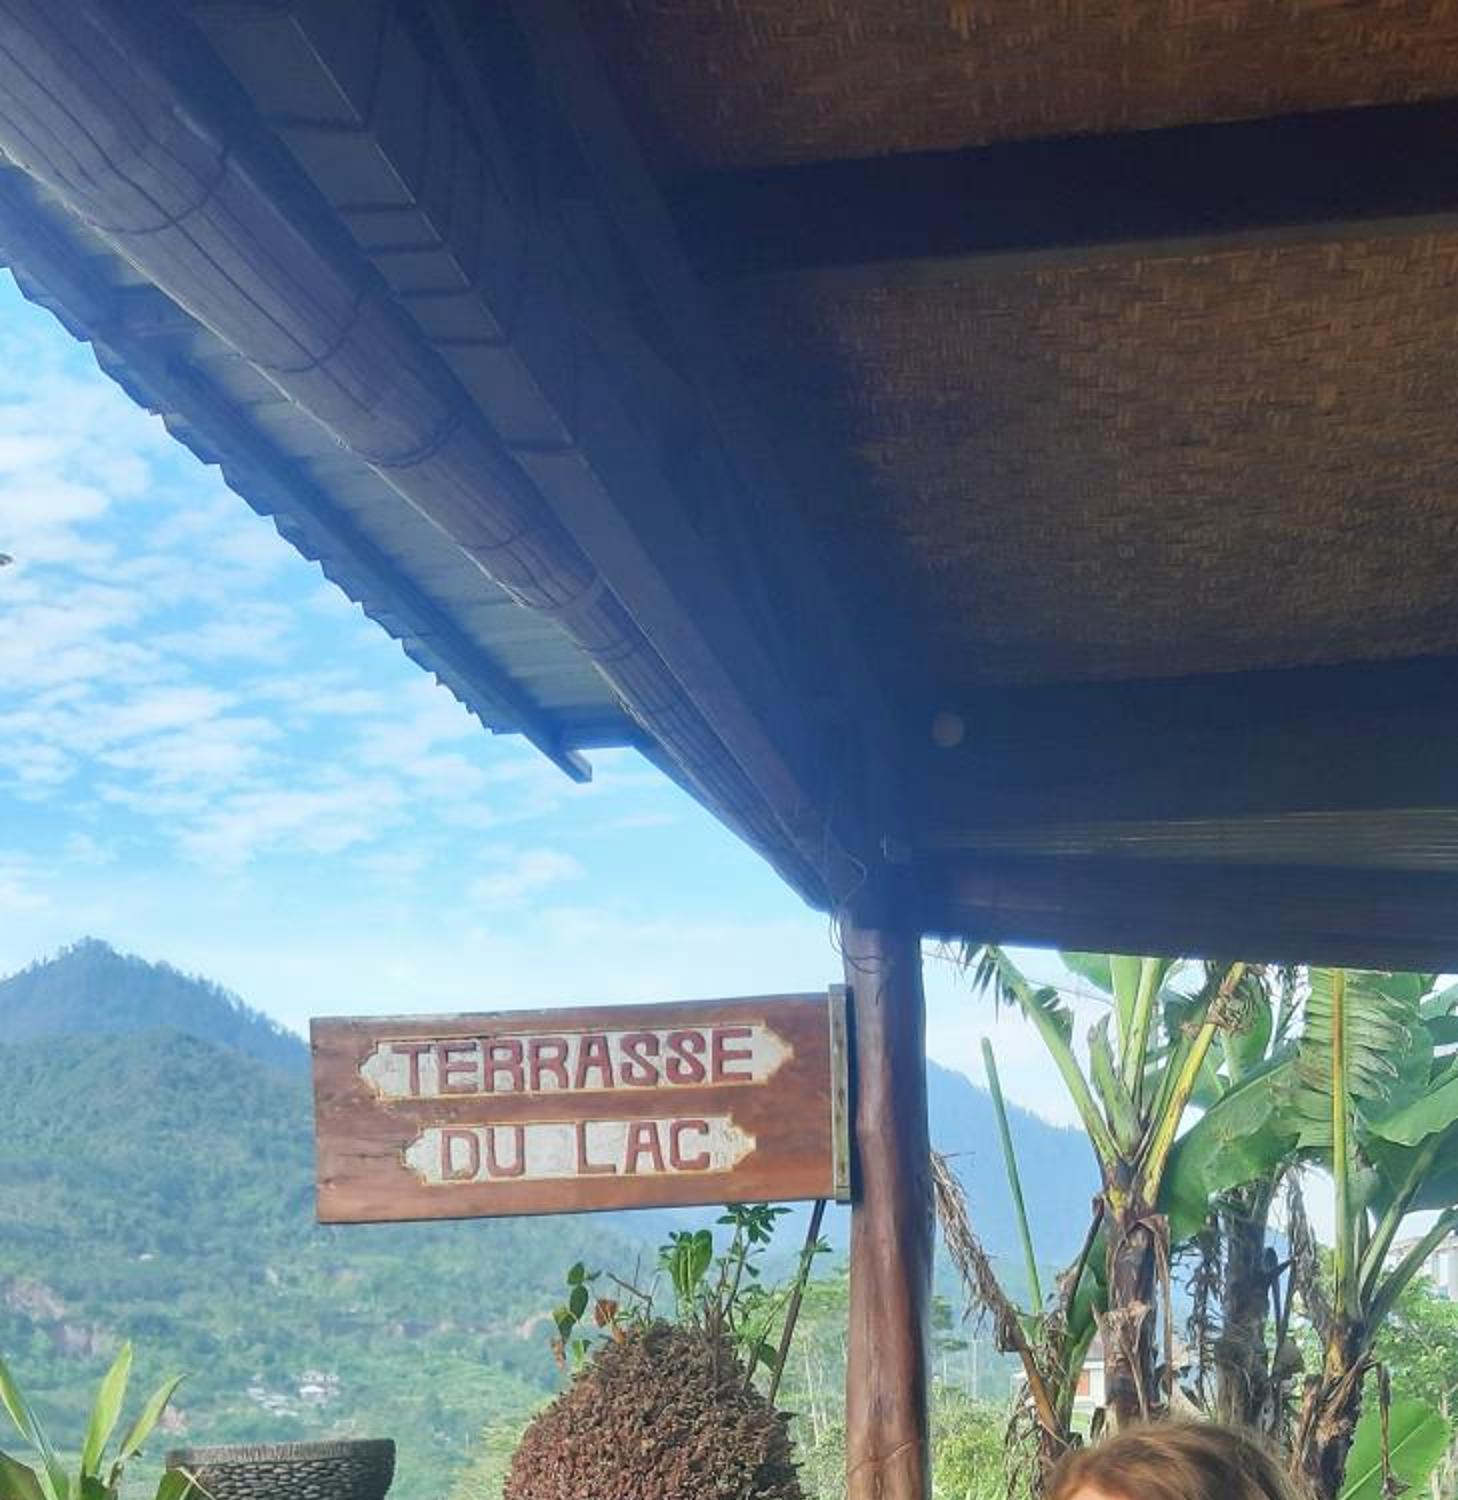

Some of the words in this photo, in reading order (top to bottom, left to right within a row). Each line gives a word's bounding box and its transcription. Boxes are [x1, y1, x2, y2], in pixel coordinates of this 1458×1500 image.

[392, 1027, 753, 1096] TERRASSE
[440, 1125, 526, 1181] DU
[576, 1118, 711, 1175] LAC
